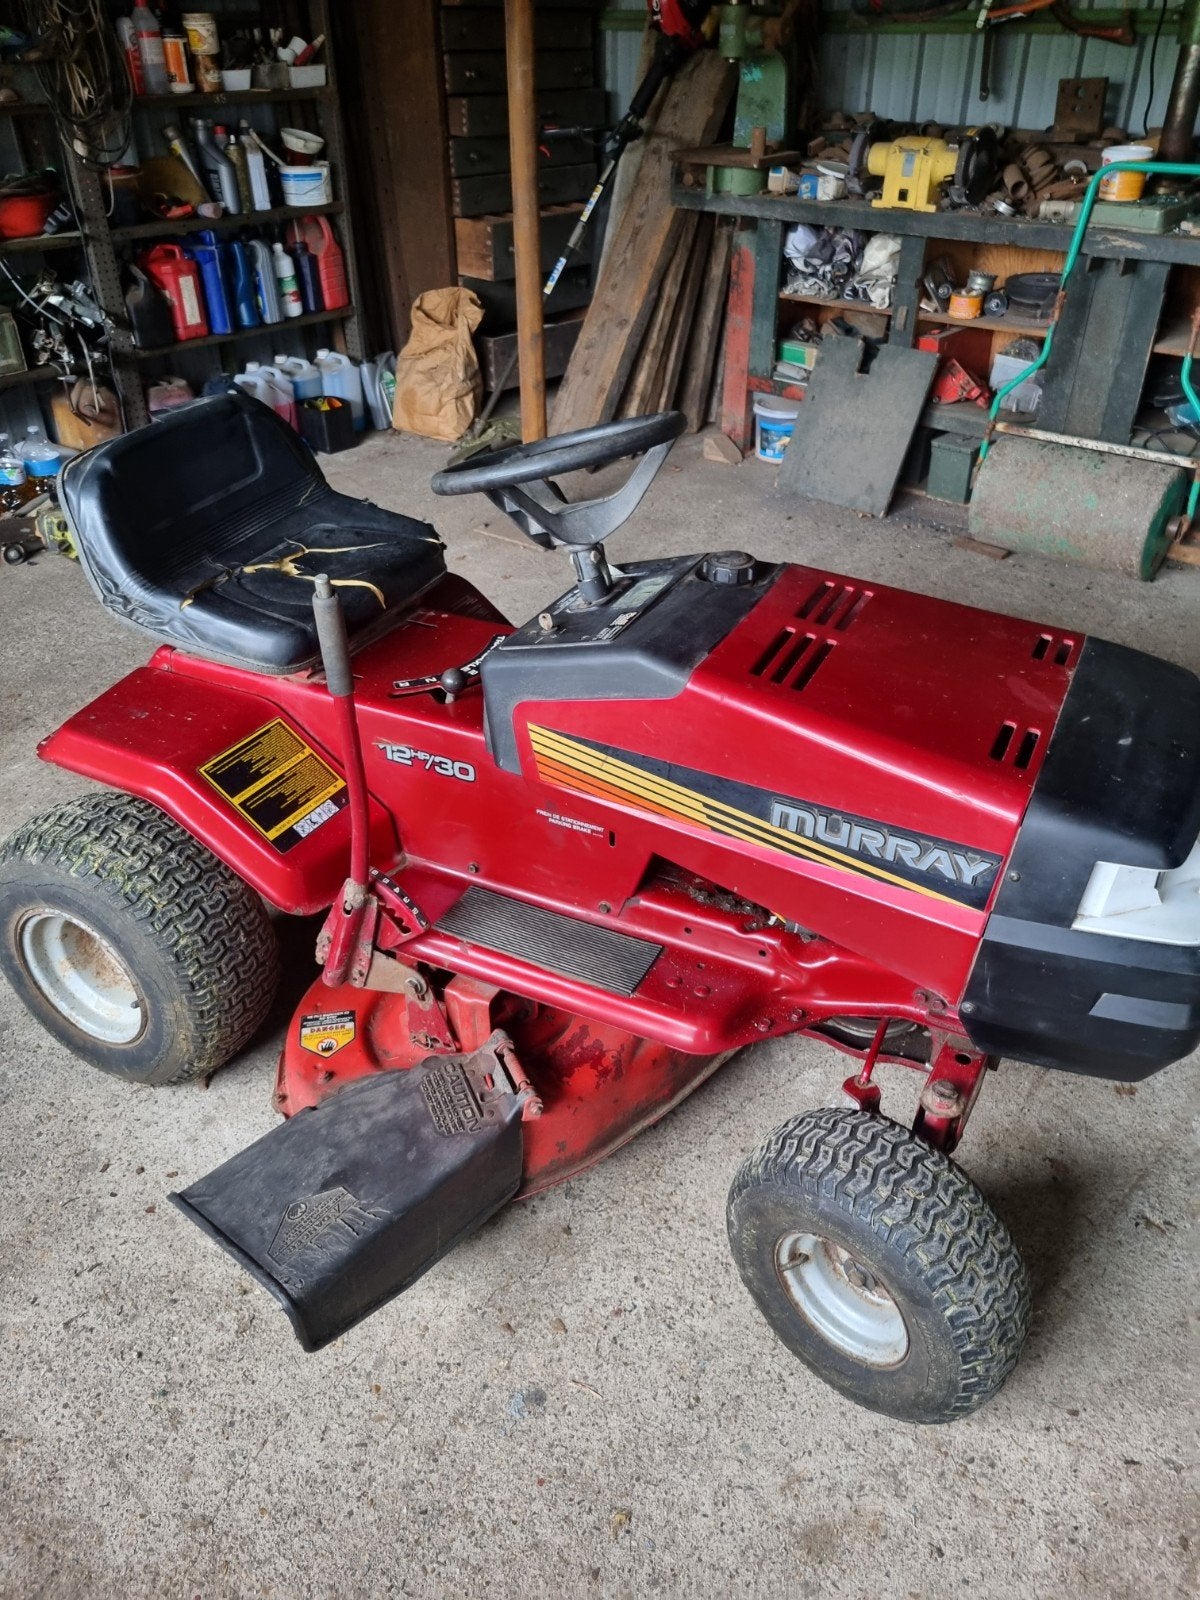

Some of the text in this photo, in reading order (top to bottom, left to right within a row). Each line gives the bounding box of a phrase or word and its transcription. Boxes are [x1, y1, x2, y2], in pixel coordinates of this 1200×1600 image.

[549, 818, 591, 834] PARKING BRAKE
[770, 800, 997, 885] MURRAY
[444, 1063, 482, 1132] CAUTION
